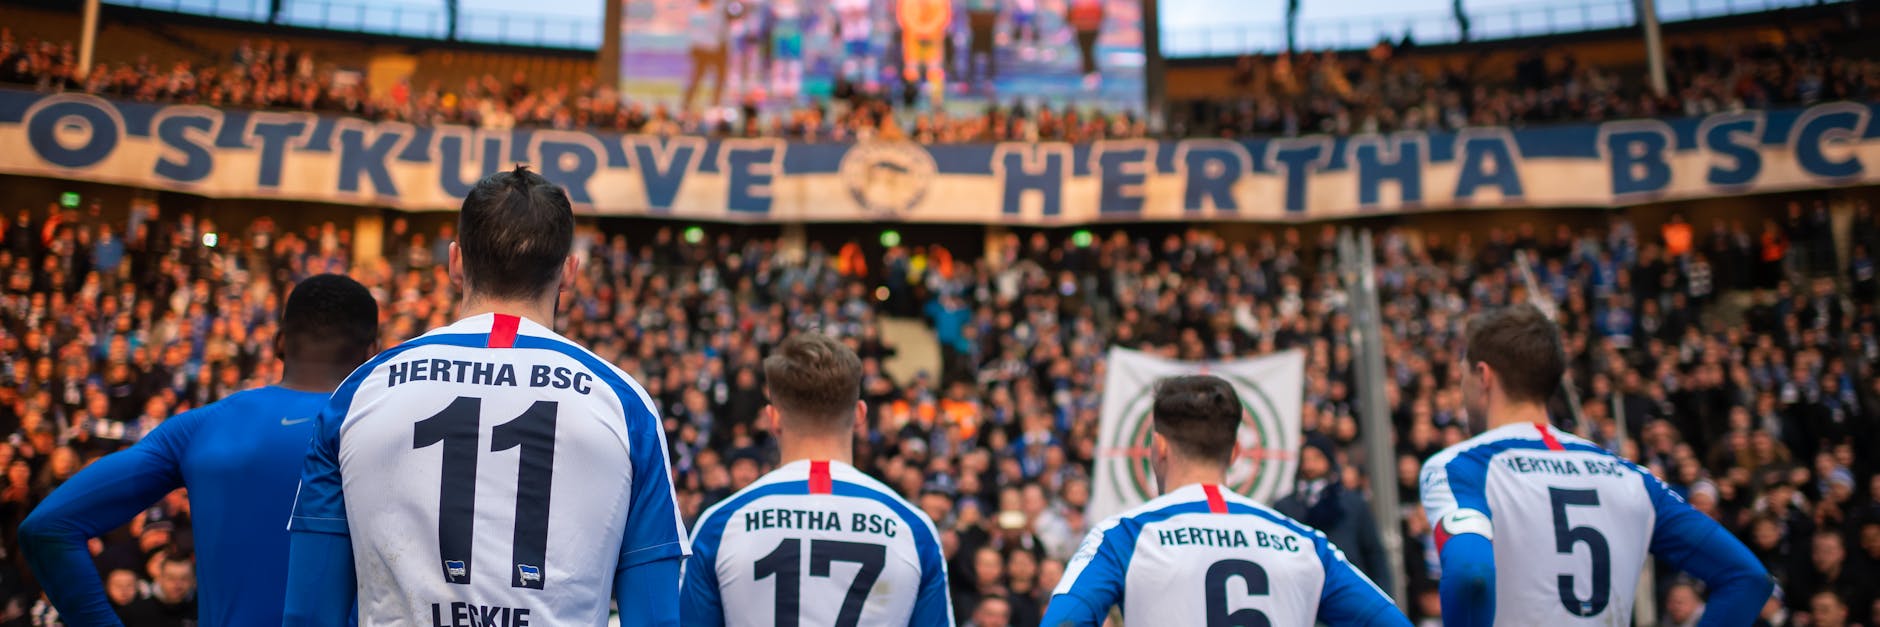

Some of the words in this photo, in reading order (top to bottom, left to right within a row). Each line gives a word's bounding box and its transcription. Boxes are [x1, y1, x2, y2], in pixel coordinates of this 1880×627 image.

[25, 98, 781, 214] OSTKURVE
[1001, 136, 1524, 217] HERTHA
[1606, 110, 1868, 195] BSC
[388, 358, 518, 388] HERTHA
[530, 364, 593, 395] BSC
[413, 396, 559, 590] 11
[745, 508, 842, 532] HERTHA
[851, 513, 897, 538] BSC
[754, 538, 887, 627] 17
[1159, 527, 1248, 548] HERTHA
[1257, 531, 1300, 553] BSC
[1548, 486, 1611, 618] 5
